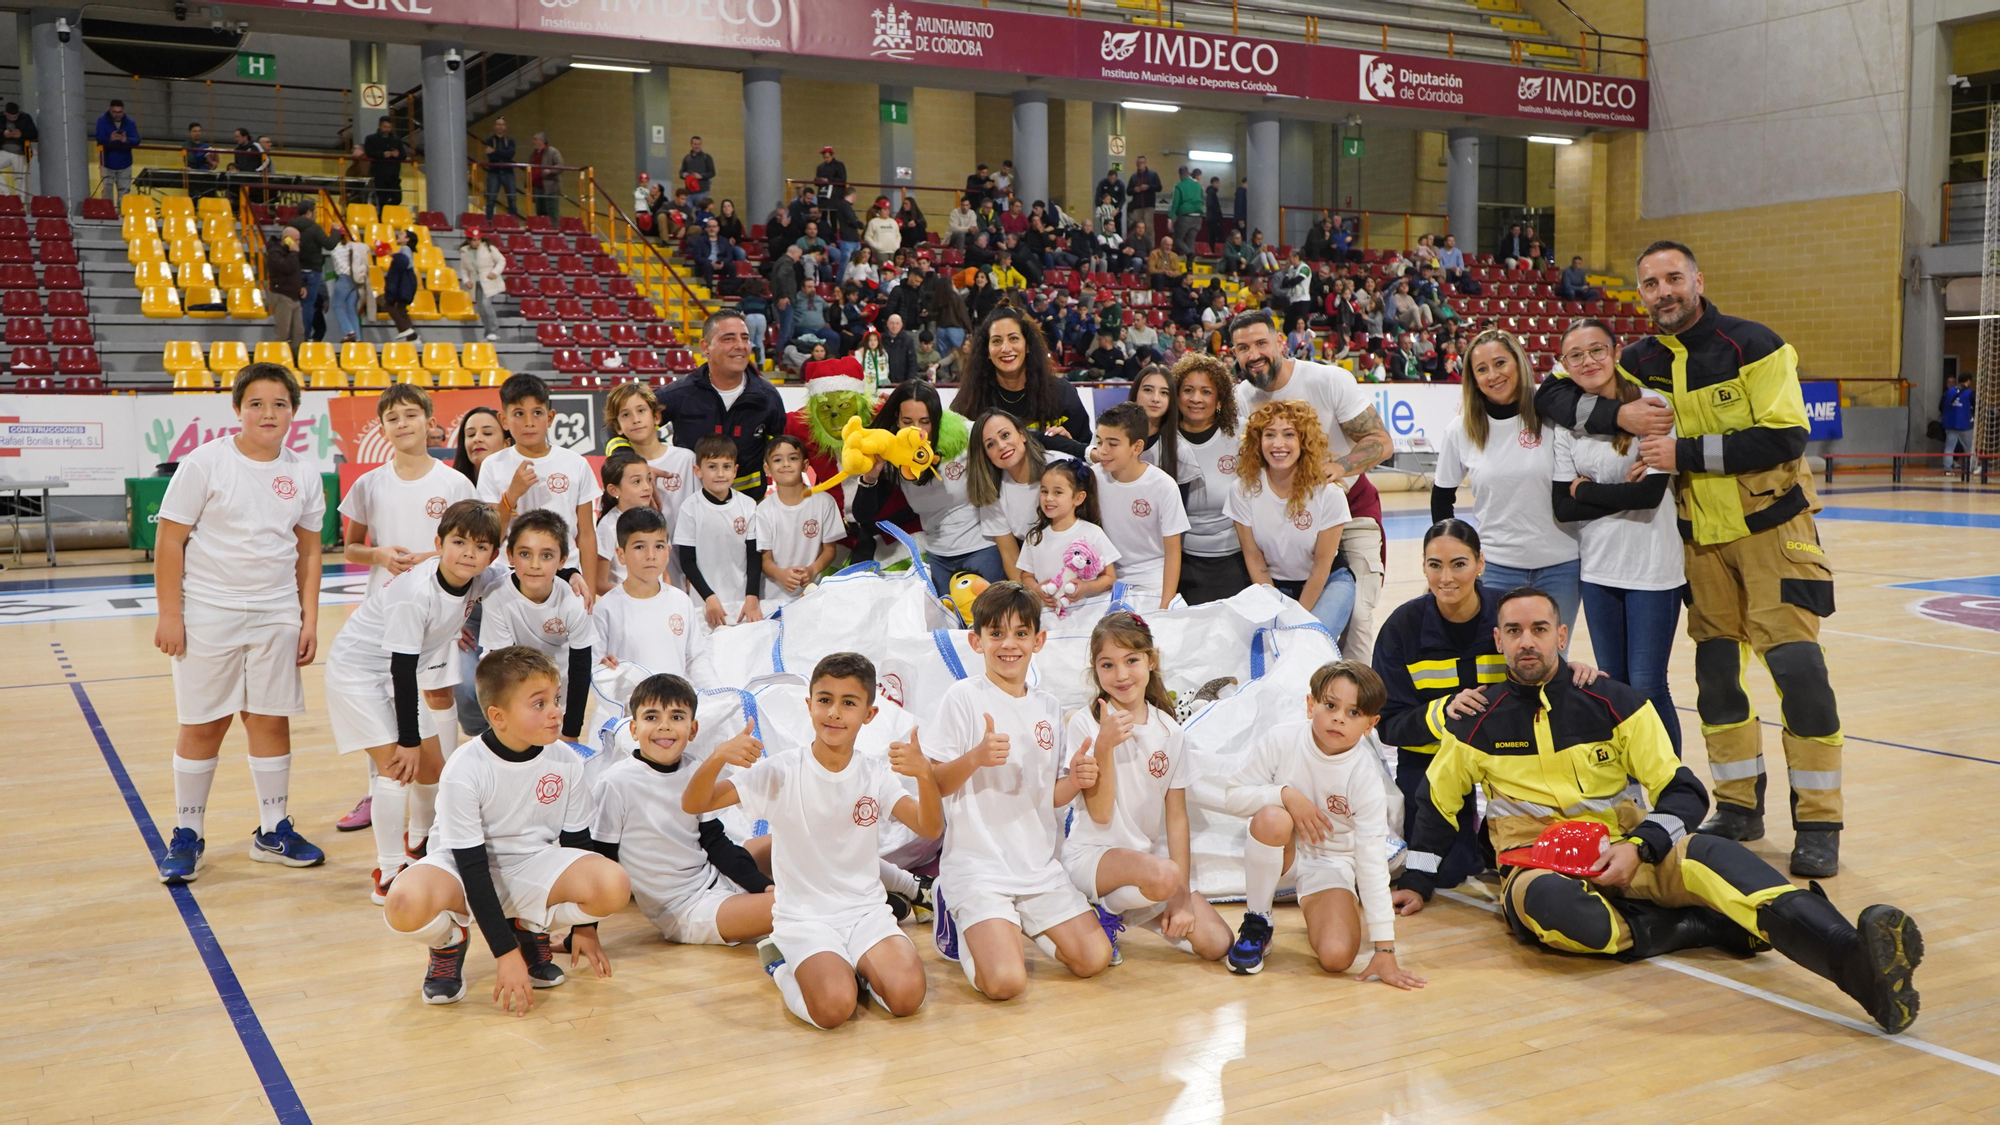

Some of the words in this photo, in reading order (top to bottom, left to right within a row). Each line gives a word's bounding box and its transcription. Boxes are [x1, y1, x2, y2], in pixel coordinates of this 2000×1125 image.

[540, 15, 593, 32] Instituto
[915, 16, 994, 39] AYUNTAMIENTO
[915, 35, 930, 51] DE
[931, 35, 984, 57] CÓRDOBA
[1144, 31, 1279, 76] IMDECO
[248, 56, 265, 76] H
[1101, 67, 1140, 80] Instituto
[1141, 71, 1186, 86] Municipal
[1187, 75, 1199, 86] de
[1200, 76, 1240, 90] Deportes
[1241, 80, 1278, 93] Córdoba
[1400, 68, 1463, 88] Diputación
[1400, 85, 1415, 100] de
[1417, 86, 1464, 104] Córdoba
[1546, 76, 1636, 109] IMDECO
[1518, 103, 1544, 114] Instituto
[1544, 106, 1574, 118] Municipal
[1574, 110, 1583, 118] de
[1583, 110, 1610, 120] Deportes
[1350, 140, 1358, 155] J
[11, 426, 84, 434] CONSTRUCCIONES
[548, 411, 586, 448] G3
[0, 436, 24, 446] Rafael
[26, 435, 54, 446] Bonilla
[1495, 741, 1530, 749] BOMBERO
